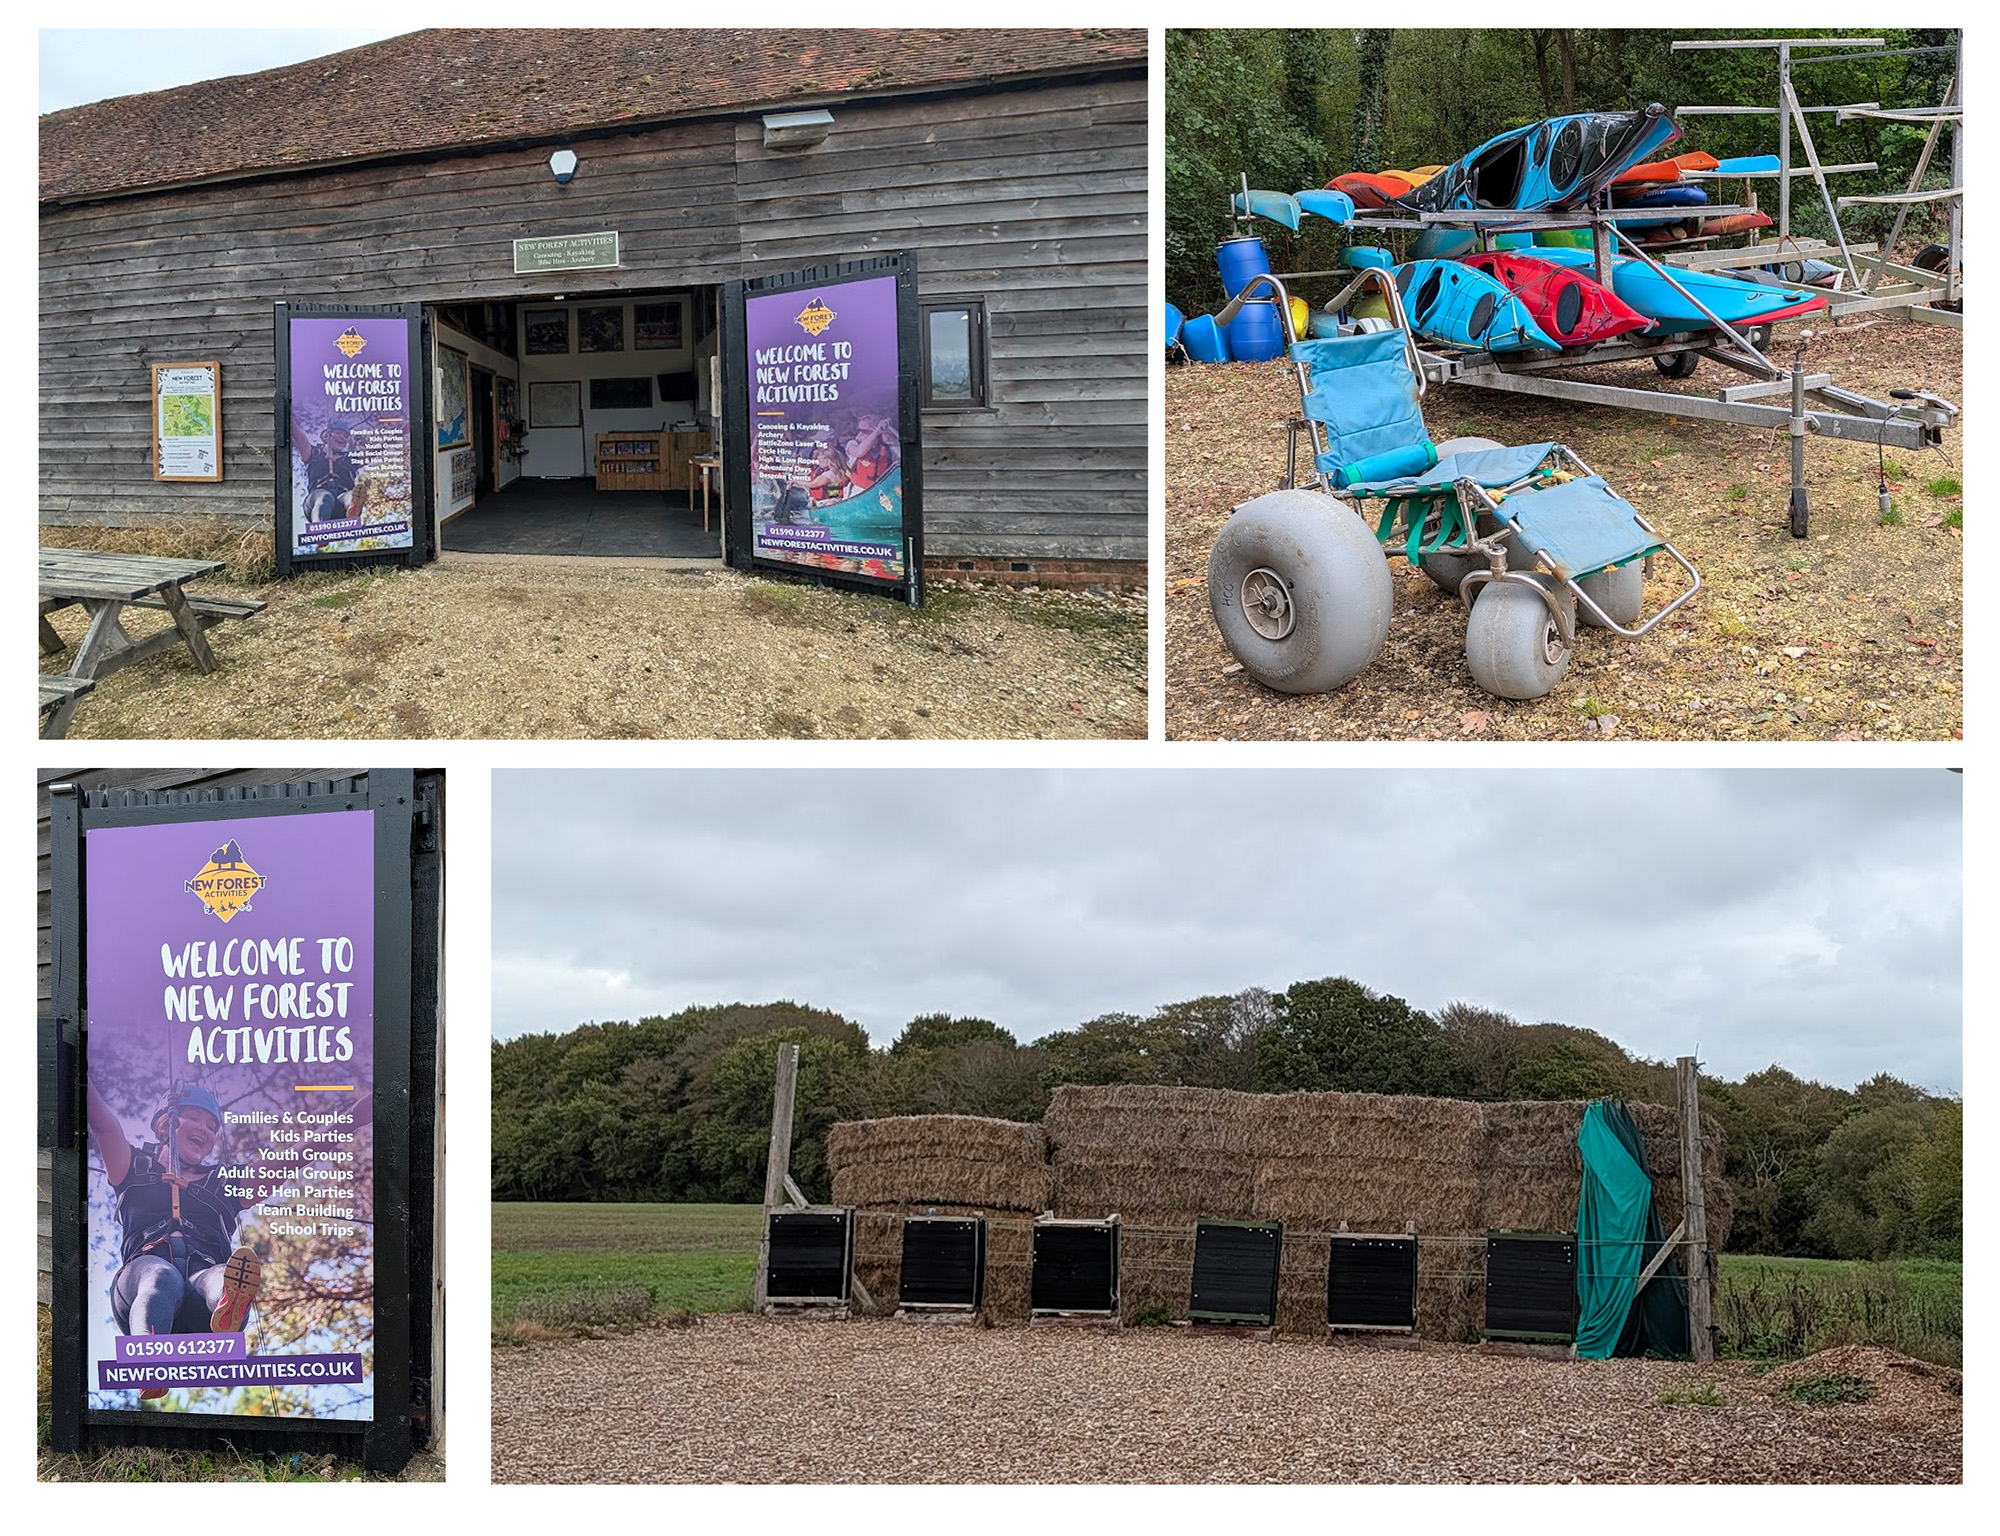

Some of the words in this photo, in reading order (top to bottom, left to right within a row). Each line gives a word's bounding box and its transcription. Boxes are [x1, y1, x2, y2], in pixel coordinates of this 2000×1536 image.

[538, 241, 568, 250] FOREST
[569, 237, 613, 247] ACTIVITIES
[755, 342, 827, 366] WELCOME
[831, 340, 852, 360] TO
[323, 363, 383, 379] WELCOME
[386, 363, 402, 378] TO
[756, 365, 790, 385] NEW
[794, 362, 851, 383] FOREST
[324, 381, 355, 396] NEW
[357, 380, 402, 395] FOREST
[756, 383, 839, 404] ACTIVITIES
[334, 396, 403, 412] ACTIVITIES
[757, 423, 789, 431] Canoeing
[796, 423, 830, 431] Kayaking
[815, 441, 828, 449] Tag
[759, 464, 793, 472] Adventure
[794, 465, 811, 473] Days
[797, 458, 819, 466] Ropes
[759, 472, 787, 480] Bespoke
[301, 524, 405, 543] NEWFORESTACTIVITIES.CO.UK
[309, 523, 332, 532] 01590
[332, 519, 358, 529] 612377
[769, 527, 794, 536] 01590
[794, 528, 826, 538] 612377
[760, 538, 892, 556] NEWFORESTACTIVITIES.CO.UK
[184, 879, 215, 893] NEW
[216, 876, 267, 891] FOREST
[204, 889, 248, 899] ACTIVITIES
[160, 936, 306, 979] WELCOME
[315, 936, 355, 975] TO
[163, 984, 234, 1023] NEW
[242, 981, 354, 1021] FOREST
[187, 1025, 354, 1065] ACTIVITIES
[223, 1111, 279, 1124] Families
[282, 1111, 294, 1124] &
[296, 1111, 354, 1126] Couples
[270, 1129, 301, 1143] Kids
[303, 1130, 354, 1143] Parties
[258, 1148, 300, 1161] Youth
[302, 1148, 354, 1163] Groups
[217, 1166, 256, 1179] Adult
[257, 1166, 300, 1180] Social
[302, 1167, 354, 1182] Groups
[223, 1184, 255, 1199] Stag
[256, 1185, 269, 1198] &
[271, 1185, 301, 1198] Hen
[303, 1185, 354, 1199] Parties
[255, 1203, 293, 1217] Team
[295, 1203, 355, 1220] Building
[269, 1222, 318, 1236] School
[319, 1222, 355, 1239] Trips
[125, 1341, 175, 1357] 01590
[176, 1338, 236, 1355] 612377
[106, 1361, 355, 1382] NEWFORESTACTIVITIES.CO.UK
